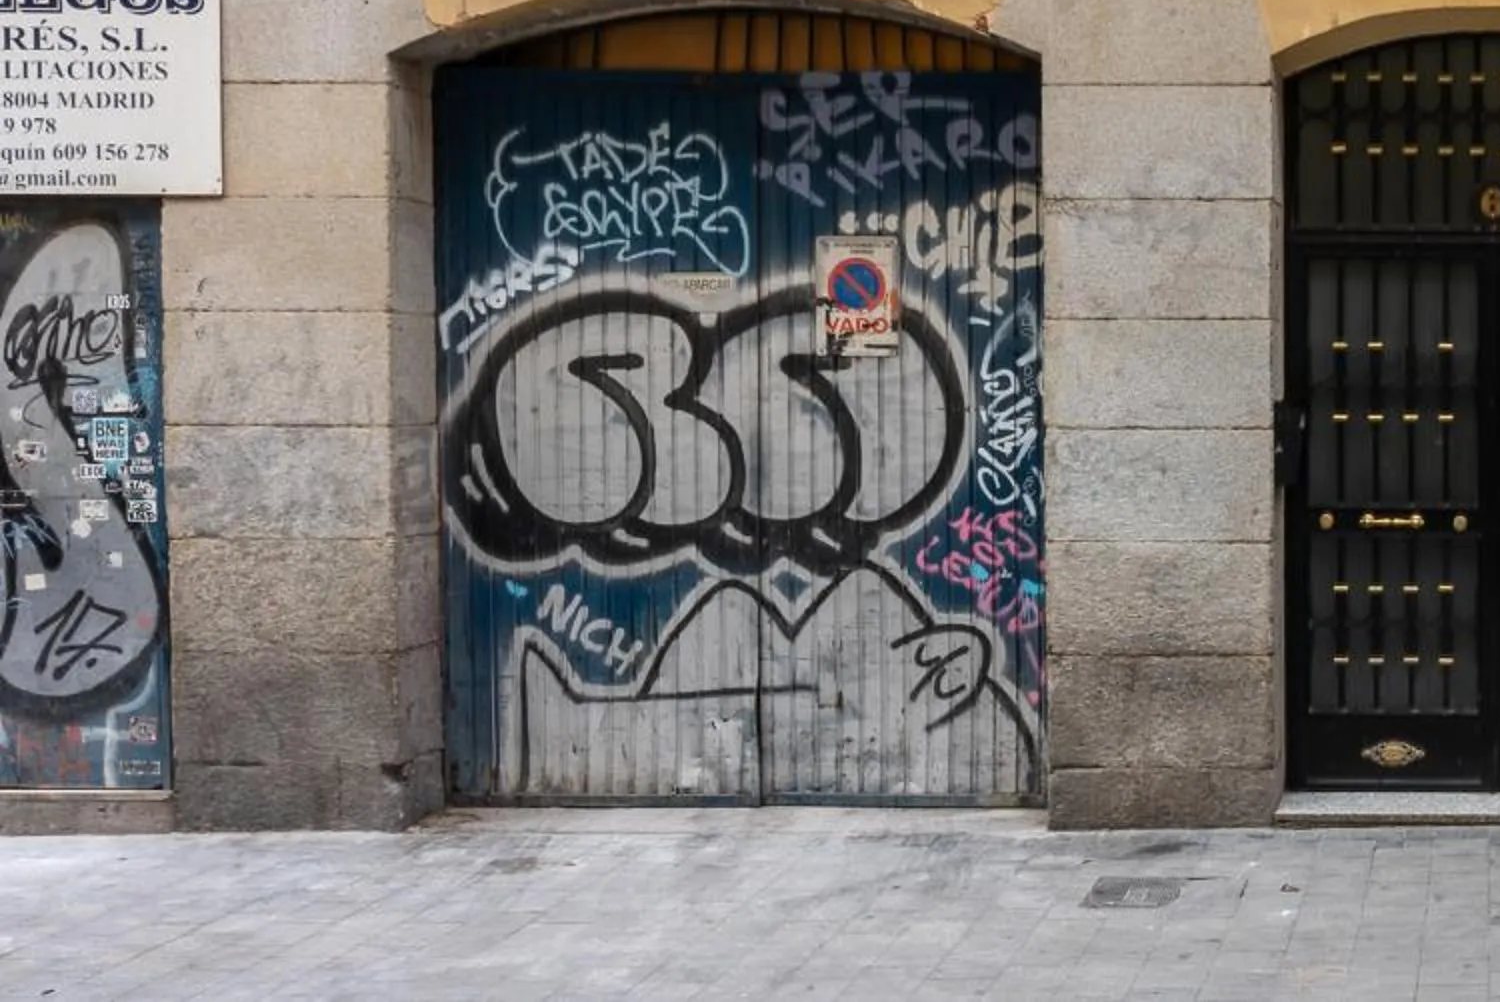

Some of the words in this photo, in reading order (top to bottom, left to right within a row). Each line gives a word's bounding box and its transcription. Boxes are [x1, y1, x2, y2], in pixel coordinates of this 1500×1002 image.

[3, 19, 88, 55] RÉS,
[101, 26, 168, 51] S.L.
[4, 60, 169, 80] LITACIONES
[3, 91, 49, 109] 8004
[56, 91, 154, 109] MADRID
[22, 117, 57, 134] 978
[52, 143, 87, 161] 609
[96, 143, 128, 161] 156
[135, 143, 170, 161] 278
[827, 317, 889, 334] VADO
[95, 421, 125, 436] BNE
[95, 449, 126, 458] HERE
